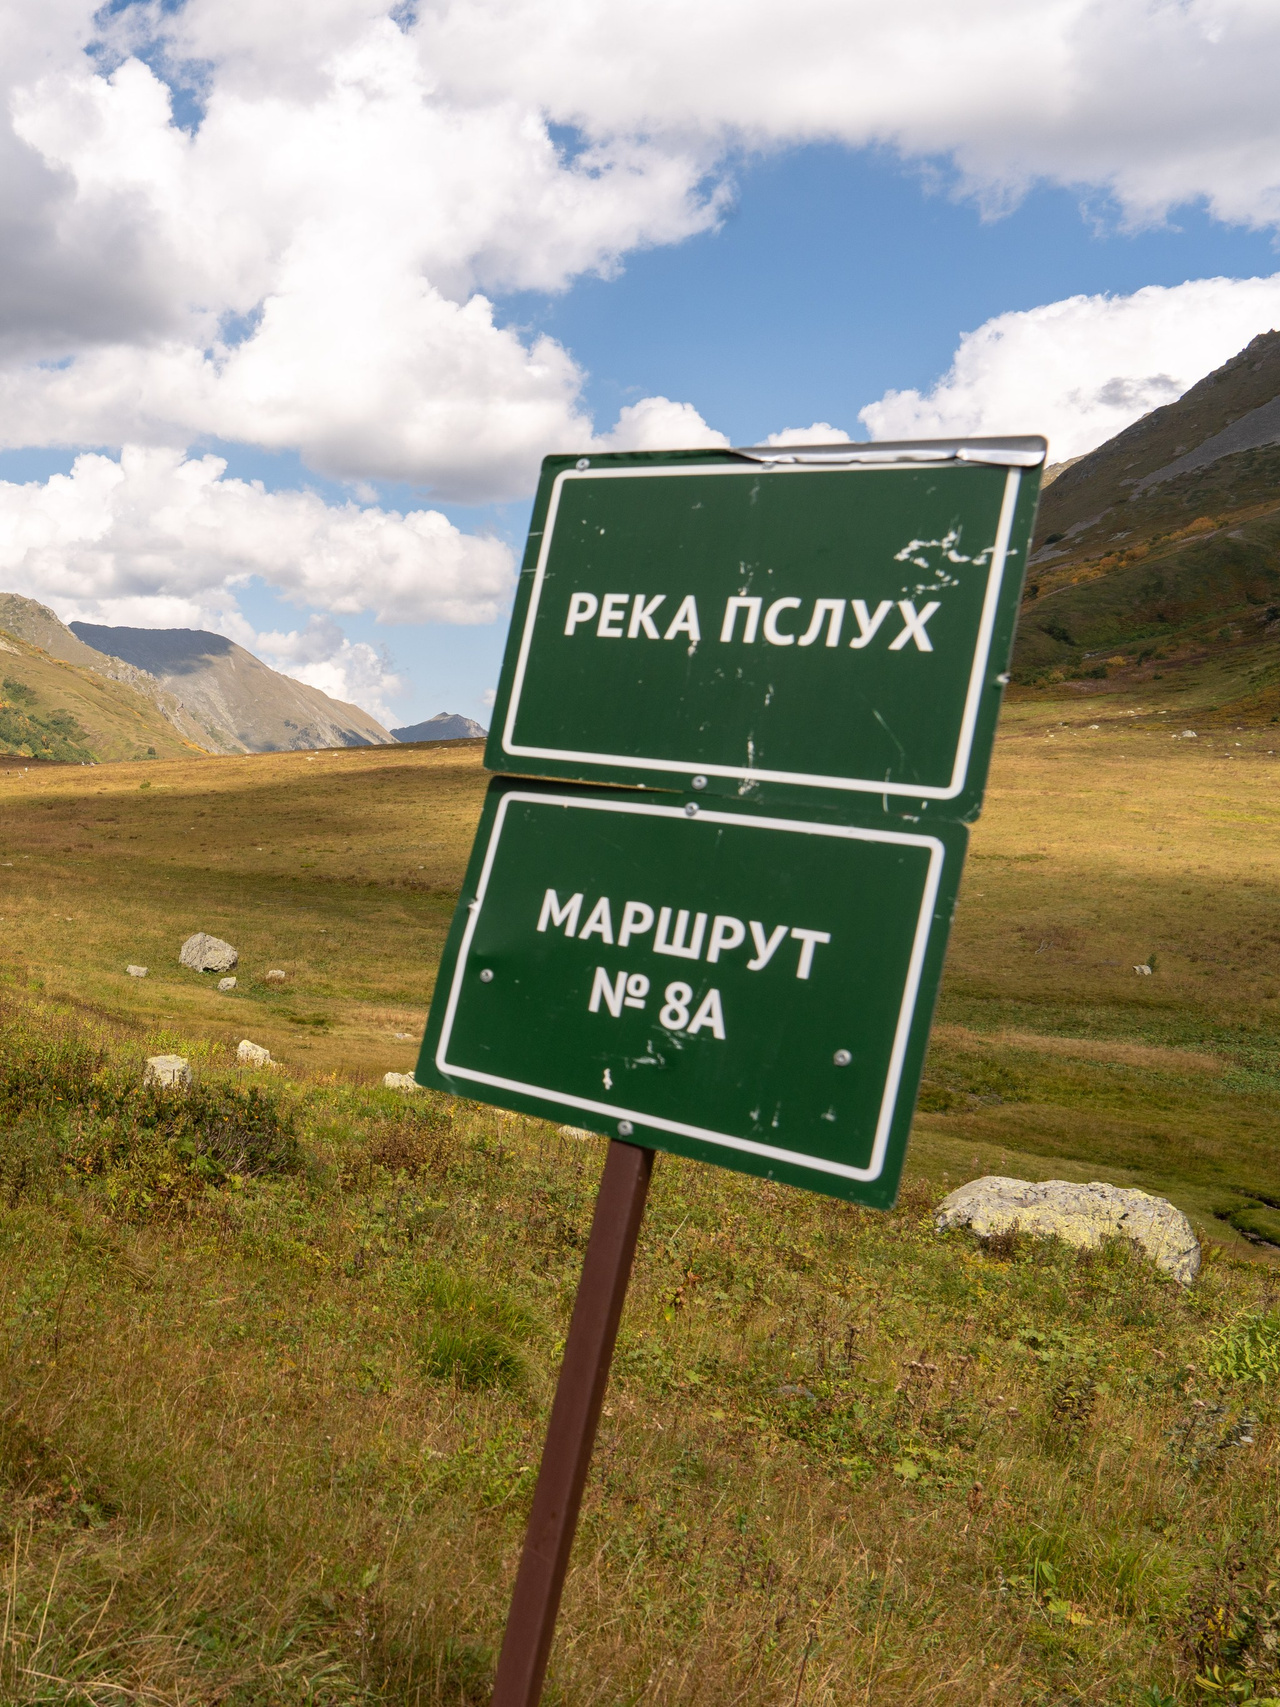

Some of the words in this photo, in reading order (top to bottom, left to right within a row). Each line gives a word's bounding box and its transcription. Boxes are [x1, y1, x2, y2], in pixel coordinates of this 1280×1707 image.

[563, 591, 702, 642] РЕКА
[719, 595, 942, 653] ПСЛУХ
[535, 888, 831, 980] МАРШРУТ
[587, 966, 650, 1018] №
[658, 980, 727, 1040] 8А
